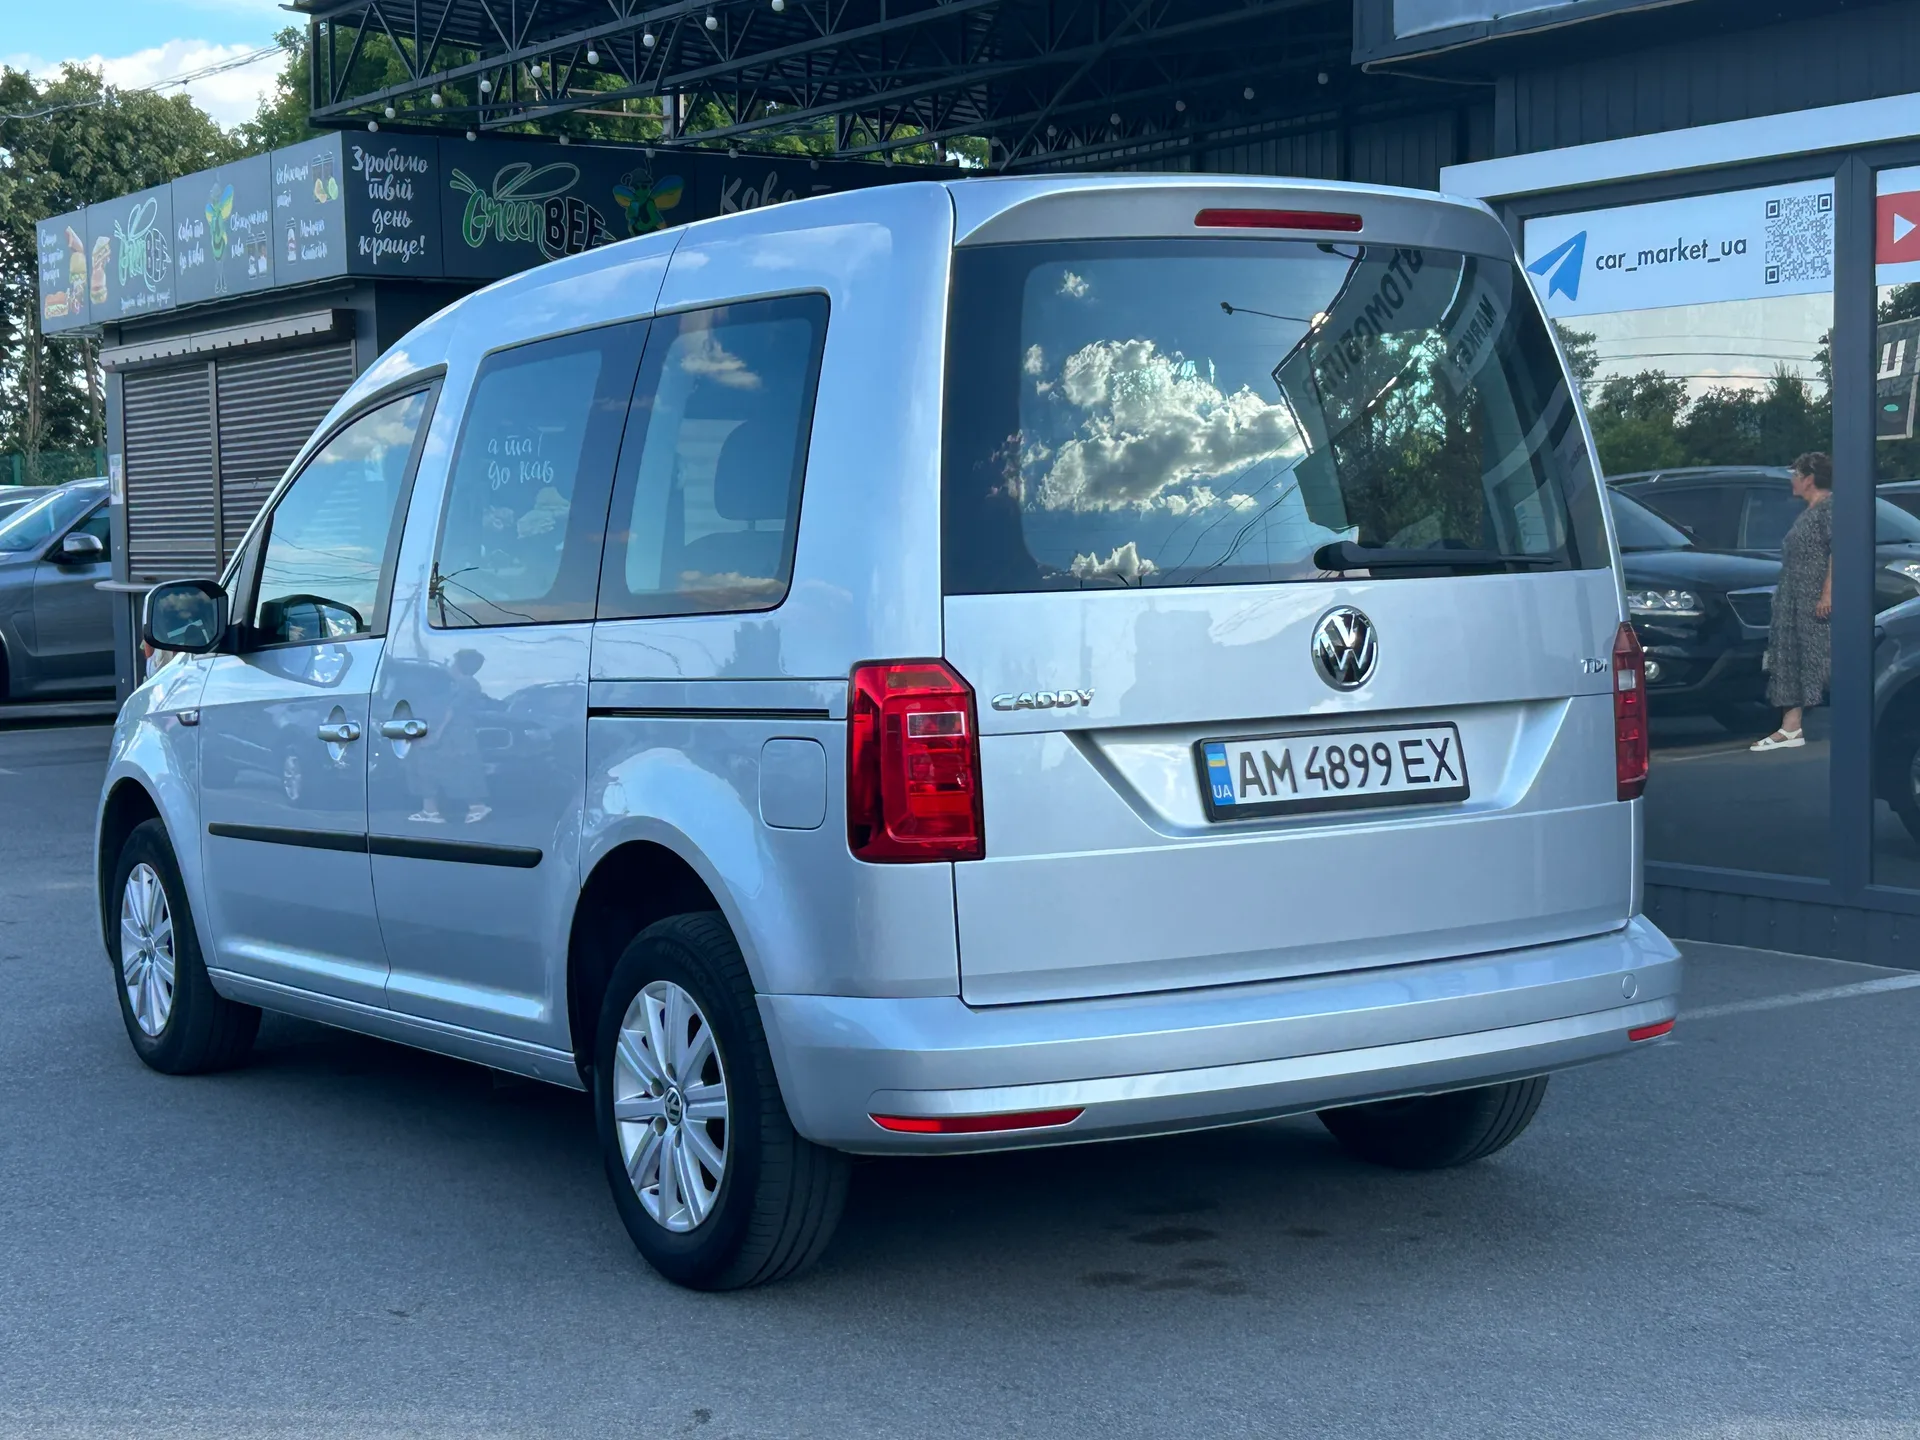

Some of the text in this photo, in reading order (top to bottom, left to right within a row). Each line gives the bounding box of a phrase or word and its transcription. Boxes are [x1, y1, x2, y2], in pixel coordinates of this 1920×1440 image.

[352, 146, 428, 181] Зробимо
[368, 173, 414, 201] твій
[372, 208, 413, 234] день
[358, 235, 425, 265] краще!
[1595, 236, 1747, 272] car_market_ua
[991, 688, 1096, 711] CADDY
[1239, 737, 1457, 798] AM 4899 EX
[1213, 785, 1232, 799] UA
